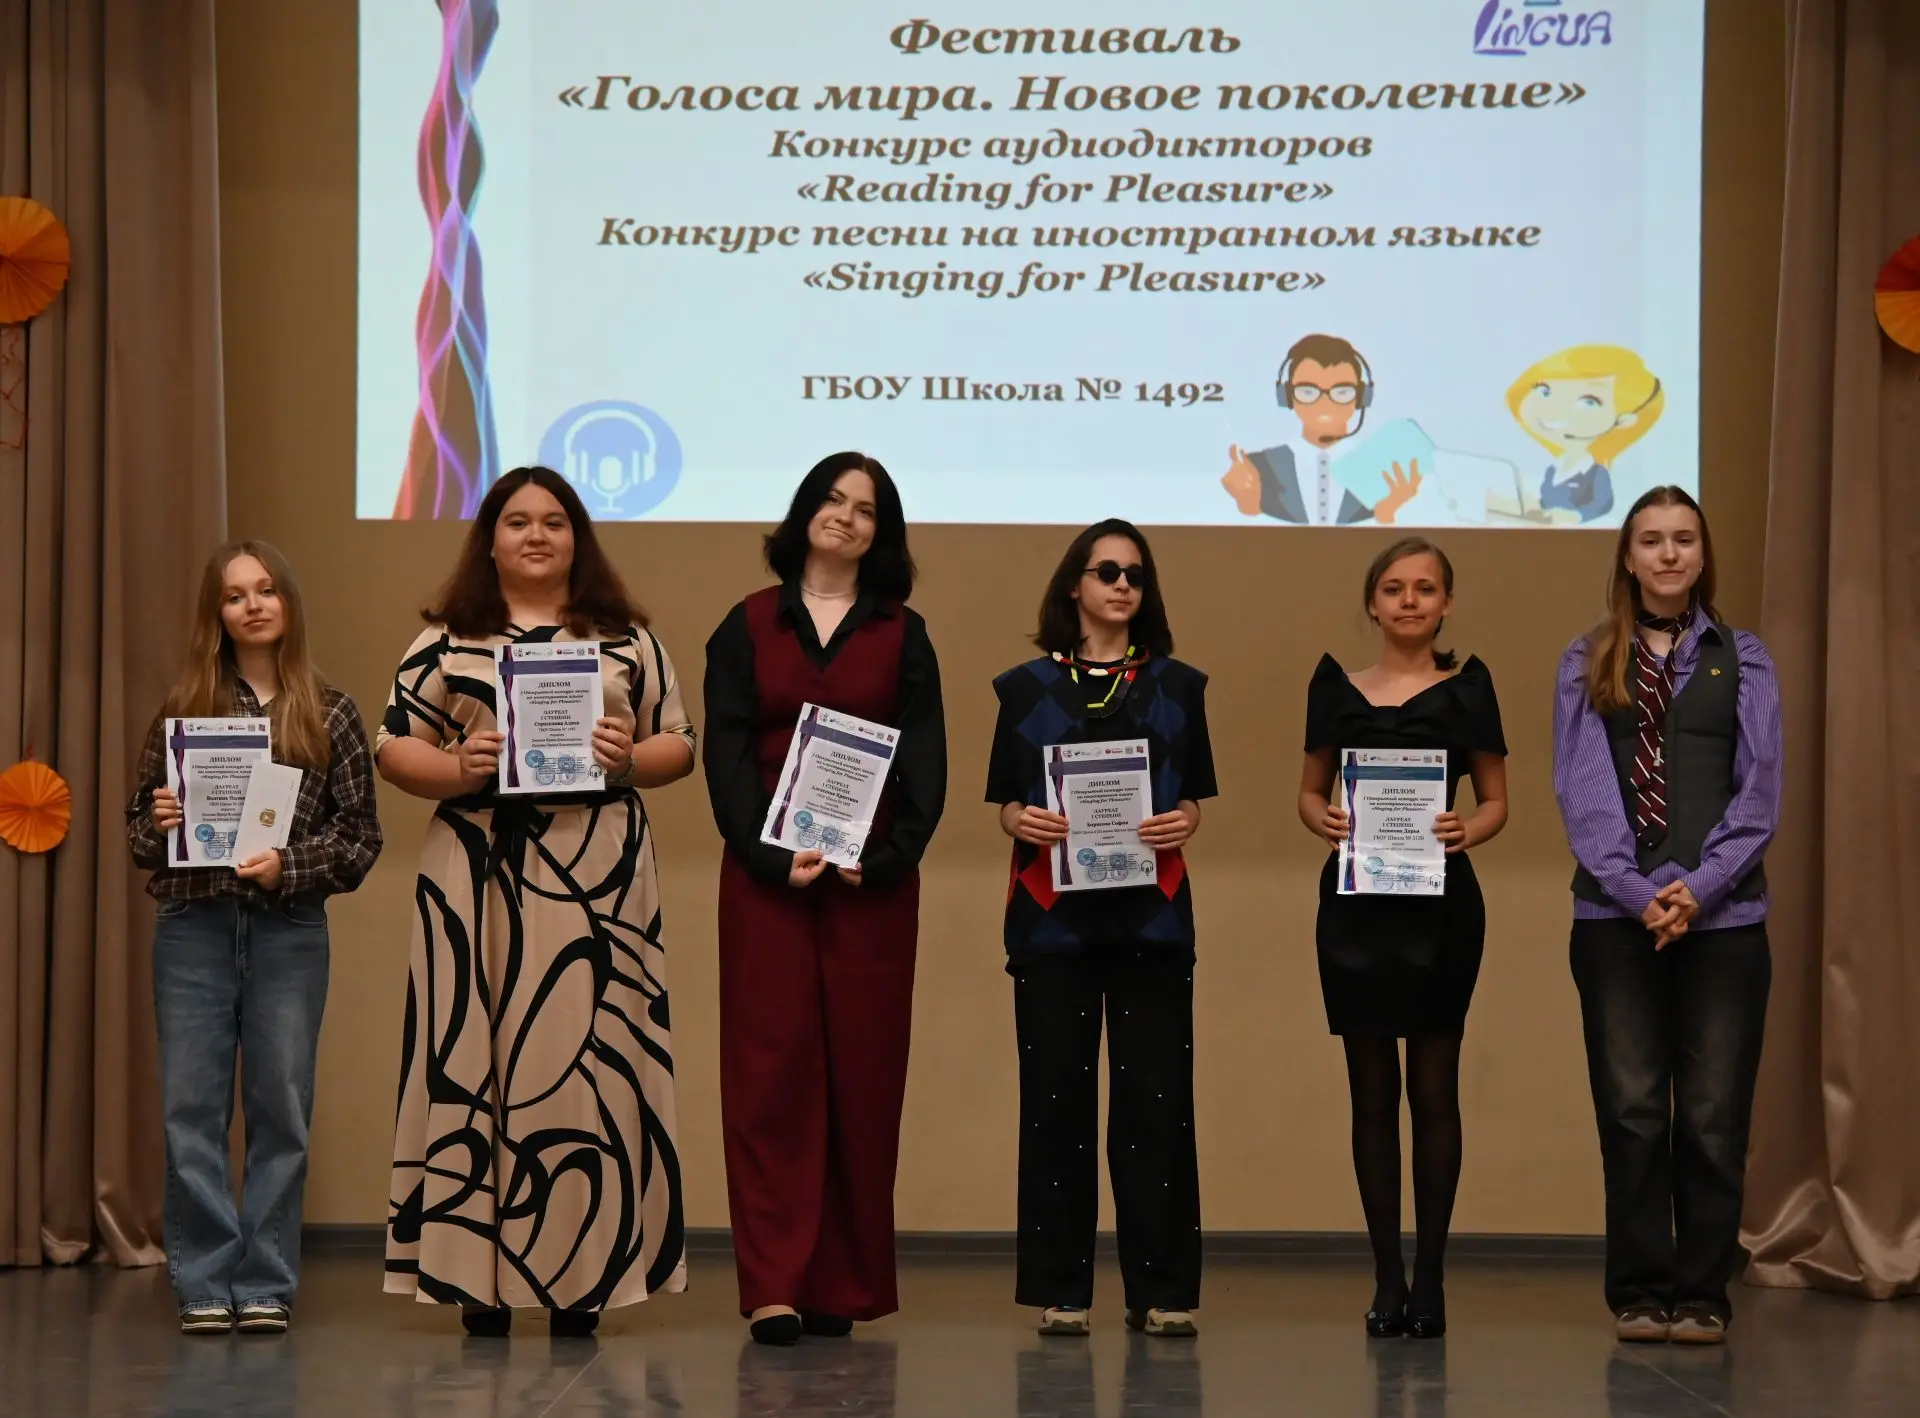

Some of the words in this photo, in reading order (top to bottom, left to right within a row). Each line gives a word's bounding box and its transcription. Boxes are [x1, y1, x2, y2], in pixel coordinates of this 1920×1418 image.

[889, 18, 1241, 55] Фестиваль
[557, 75, 801, 112] «Голоса
[813, 85, 994, 121] мира.
[1009, 76, 1201, 112] Новое
[1217, 81, 1587, 111] поколение»
[767, 129, 972, 166] Конкурс
[983, 128, 1373, 166] аудиодикторов
[797, 172, 1012, 210] «Reading
[1014, 172, 1094, 210] for
[1103, 172, 1334, 204] Pleasure»
[596, 217, 801, 254] Конкурс
[812, 226, 948, 247] песни
[961, 226, 1019, 247] на
[1032, 225, 1376, 255] иностранном
[1387, 225, 1542, 248] языке
[803, 261, 1004, 298] «Singing
[1006, 261, 1086, 299] for
[1094, 261, 1326, 293] Pleasure»
[801, 375, 912, 401] ГБОУ
[922, 376, 1064, 402] Школа
[1075, 377, 1122, 402] №
[1135, 382, 1225, 408] 1492
[830, 751, 861, 764] ДИПЛОМ
[1088, 780, 1120, 788] ДИПЛОМ
